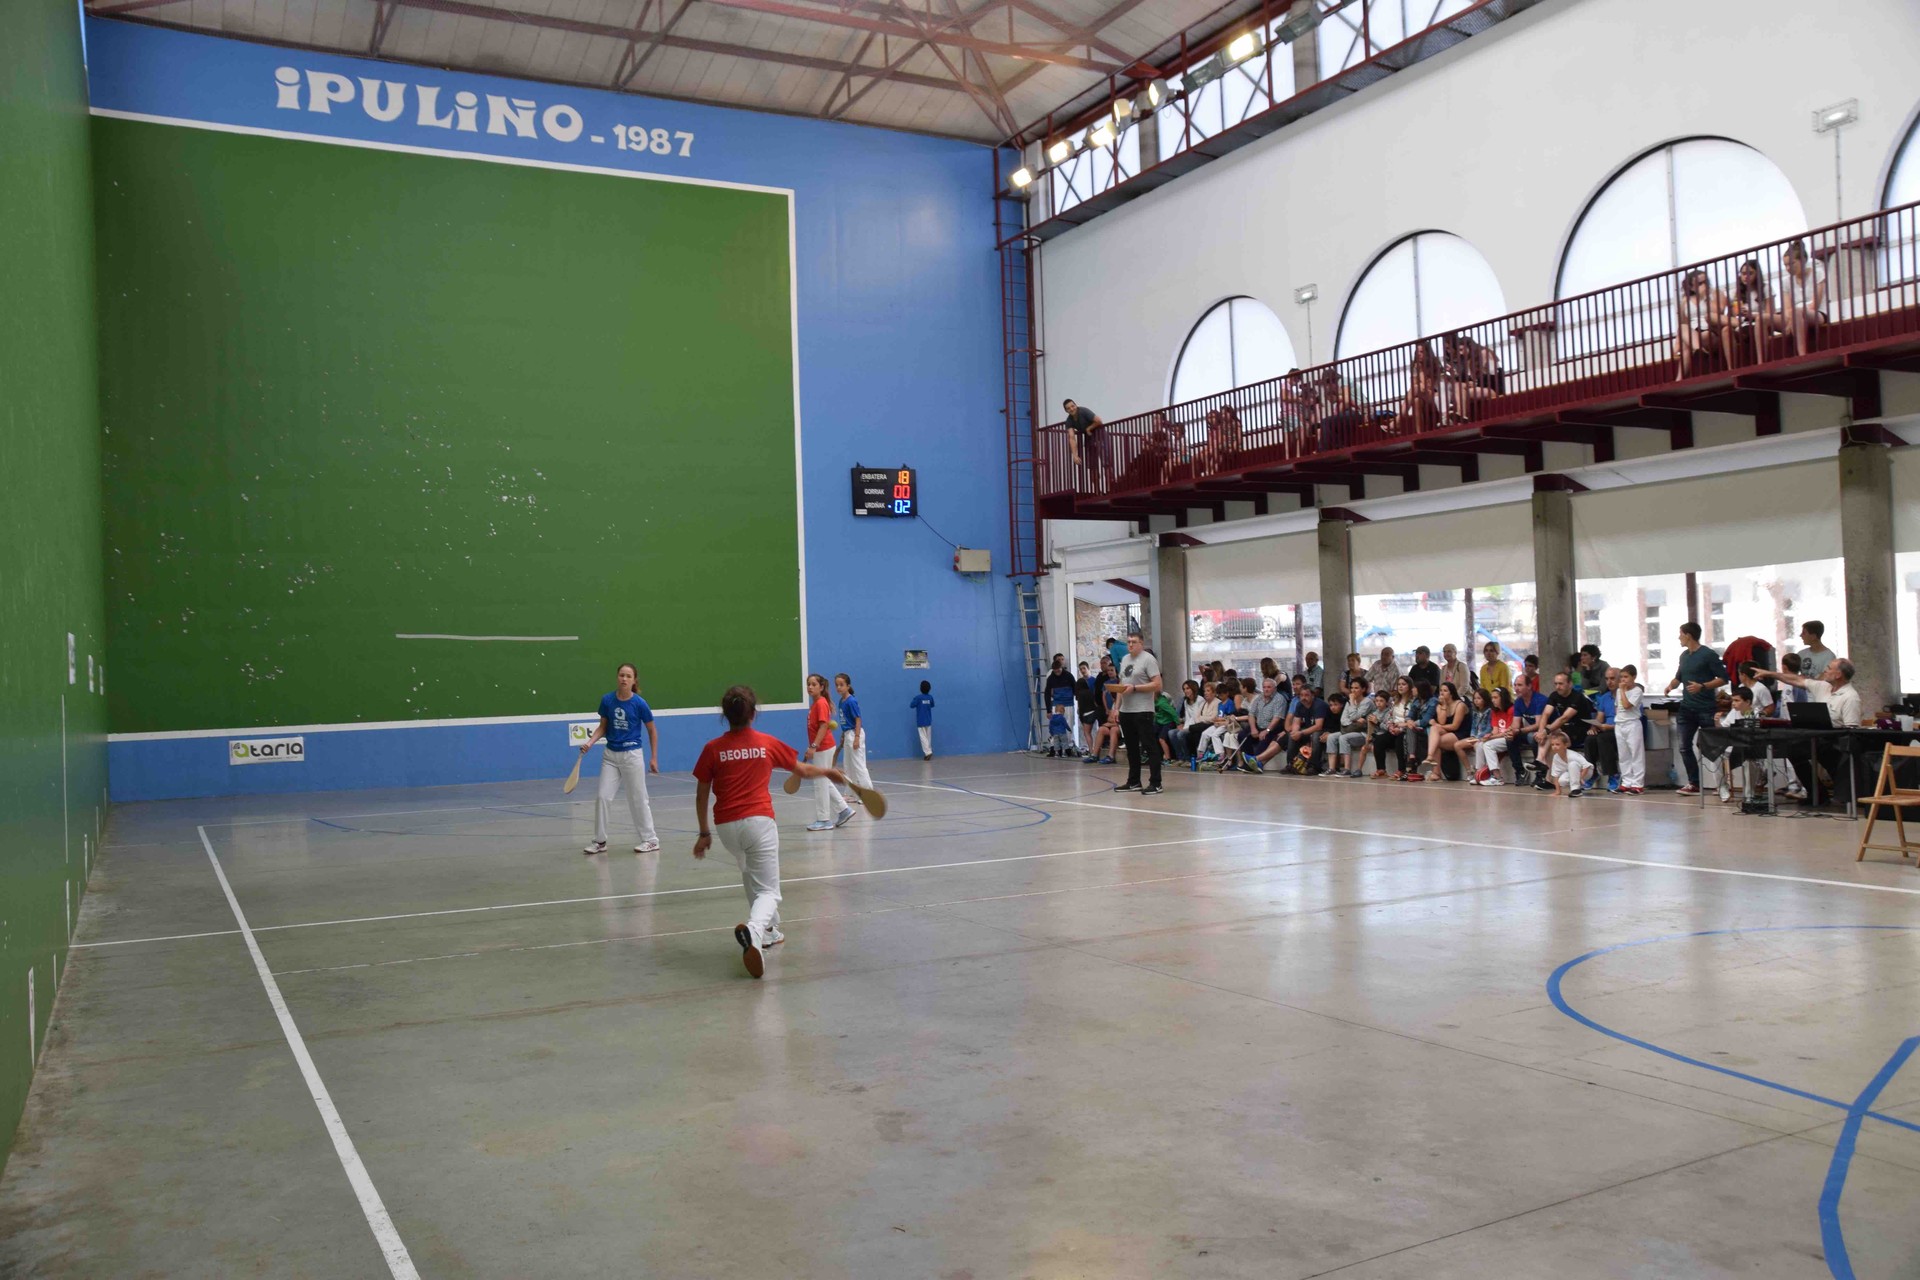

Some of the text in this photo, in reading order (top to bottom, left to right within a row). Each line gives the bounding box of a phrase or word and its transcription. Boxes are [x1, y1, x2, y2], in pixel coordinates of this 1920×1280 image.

[612, 124, 695, 157] 1987
[898, 470, 910, 484] 18
[893, 485, 910, 499] 00
[894, 499, 911, 513] 02
[719, 747, 767, 762] BEOBIDE
